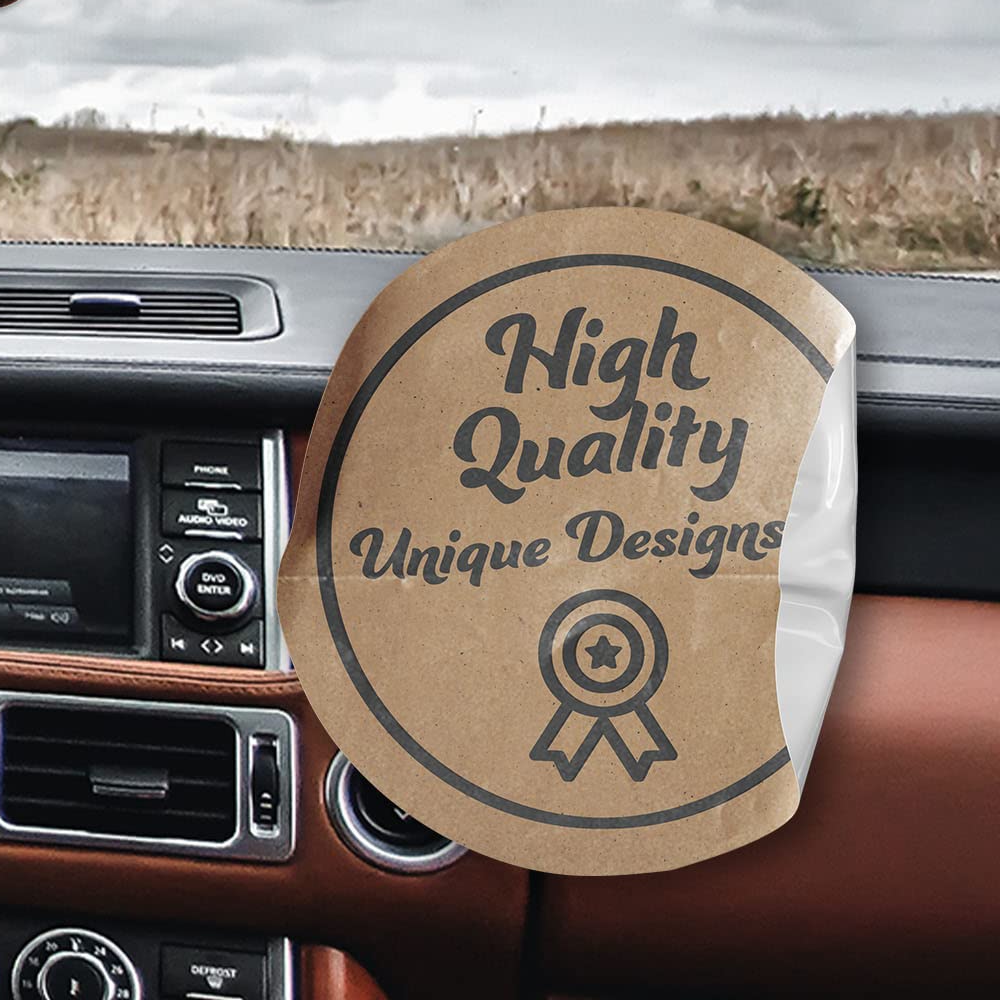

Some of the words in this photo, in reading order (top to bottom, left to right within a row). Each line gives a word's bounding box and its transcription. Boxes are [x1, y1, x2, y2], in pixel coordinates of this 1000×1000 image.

[194, 465, 229, 475] PHONE
[178, 514, 213, 525] AUDIO
[214, 516, 248, 527] VIDEO
[202, 573, 226, 583] DVD
[197, 584, 231, 595] ENTER
[191, 964, 237, 978] DEFROST
